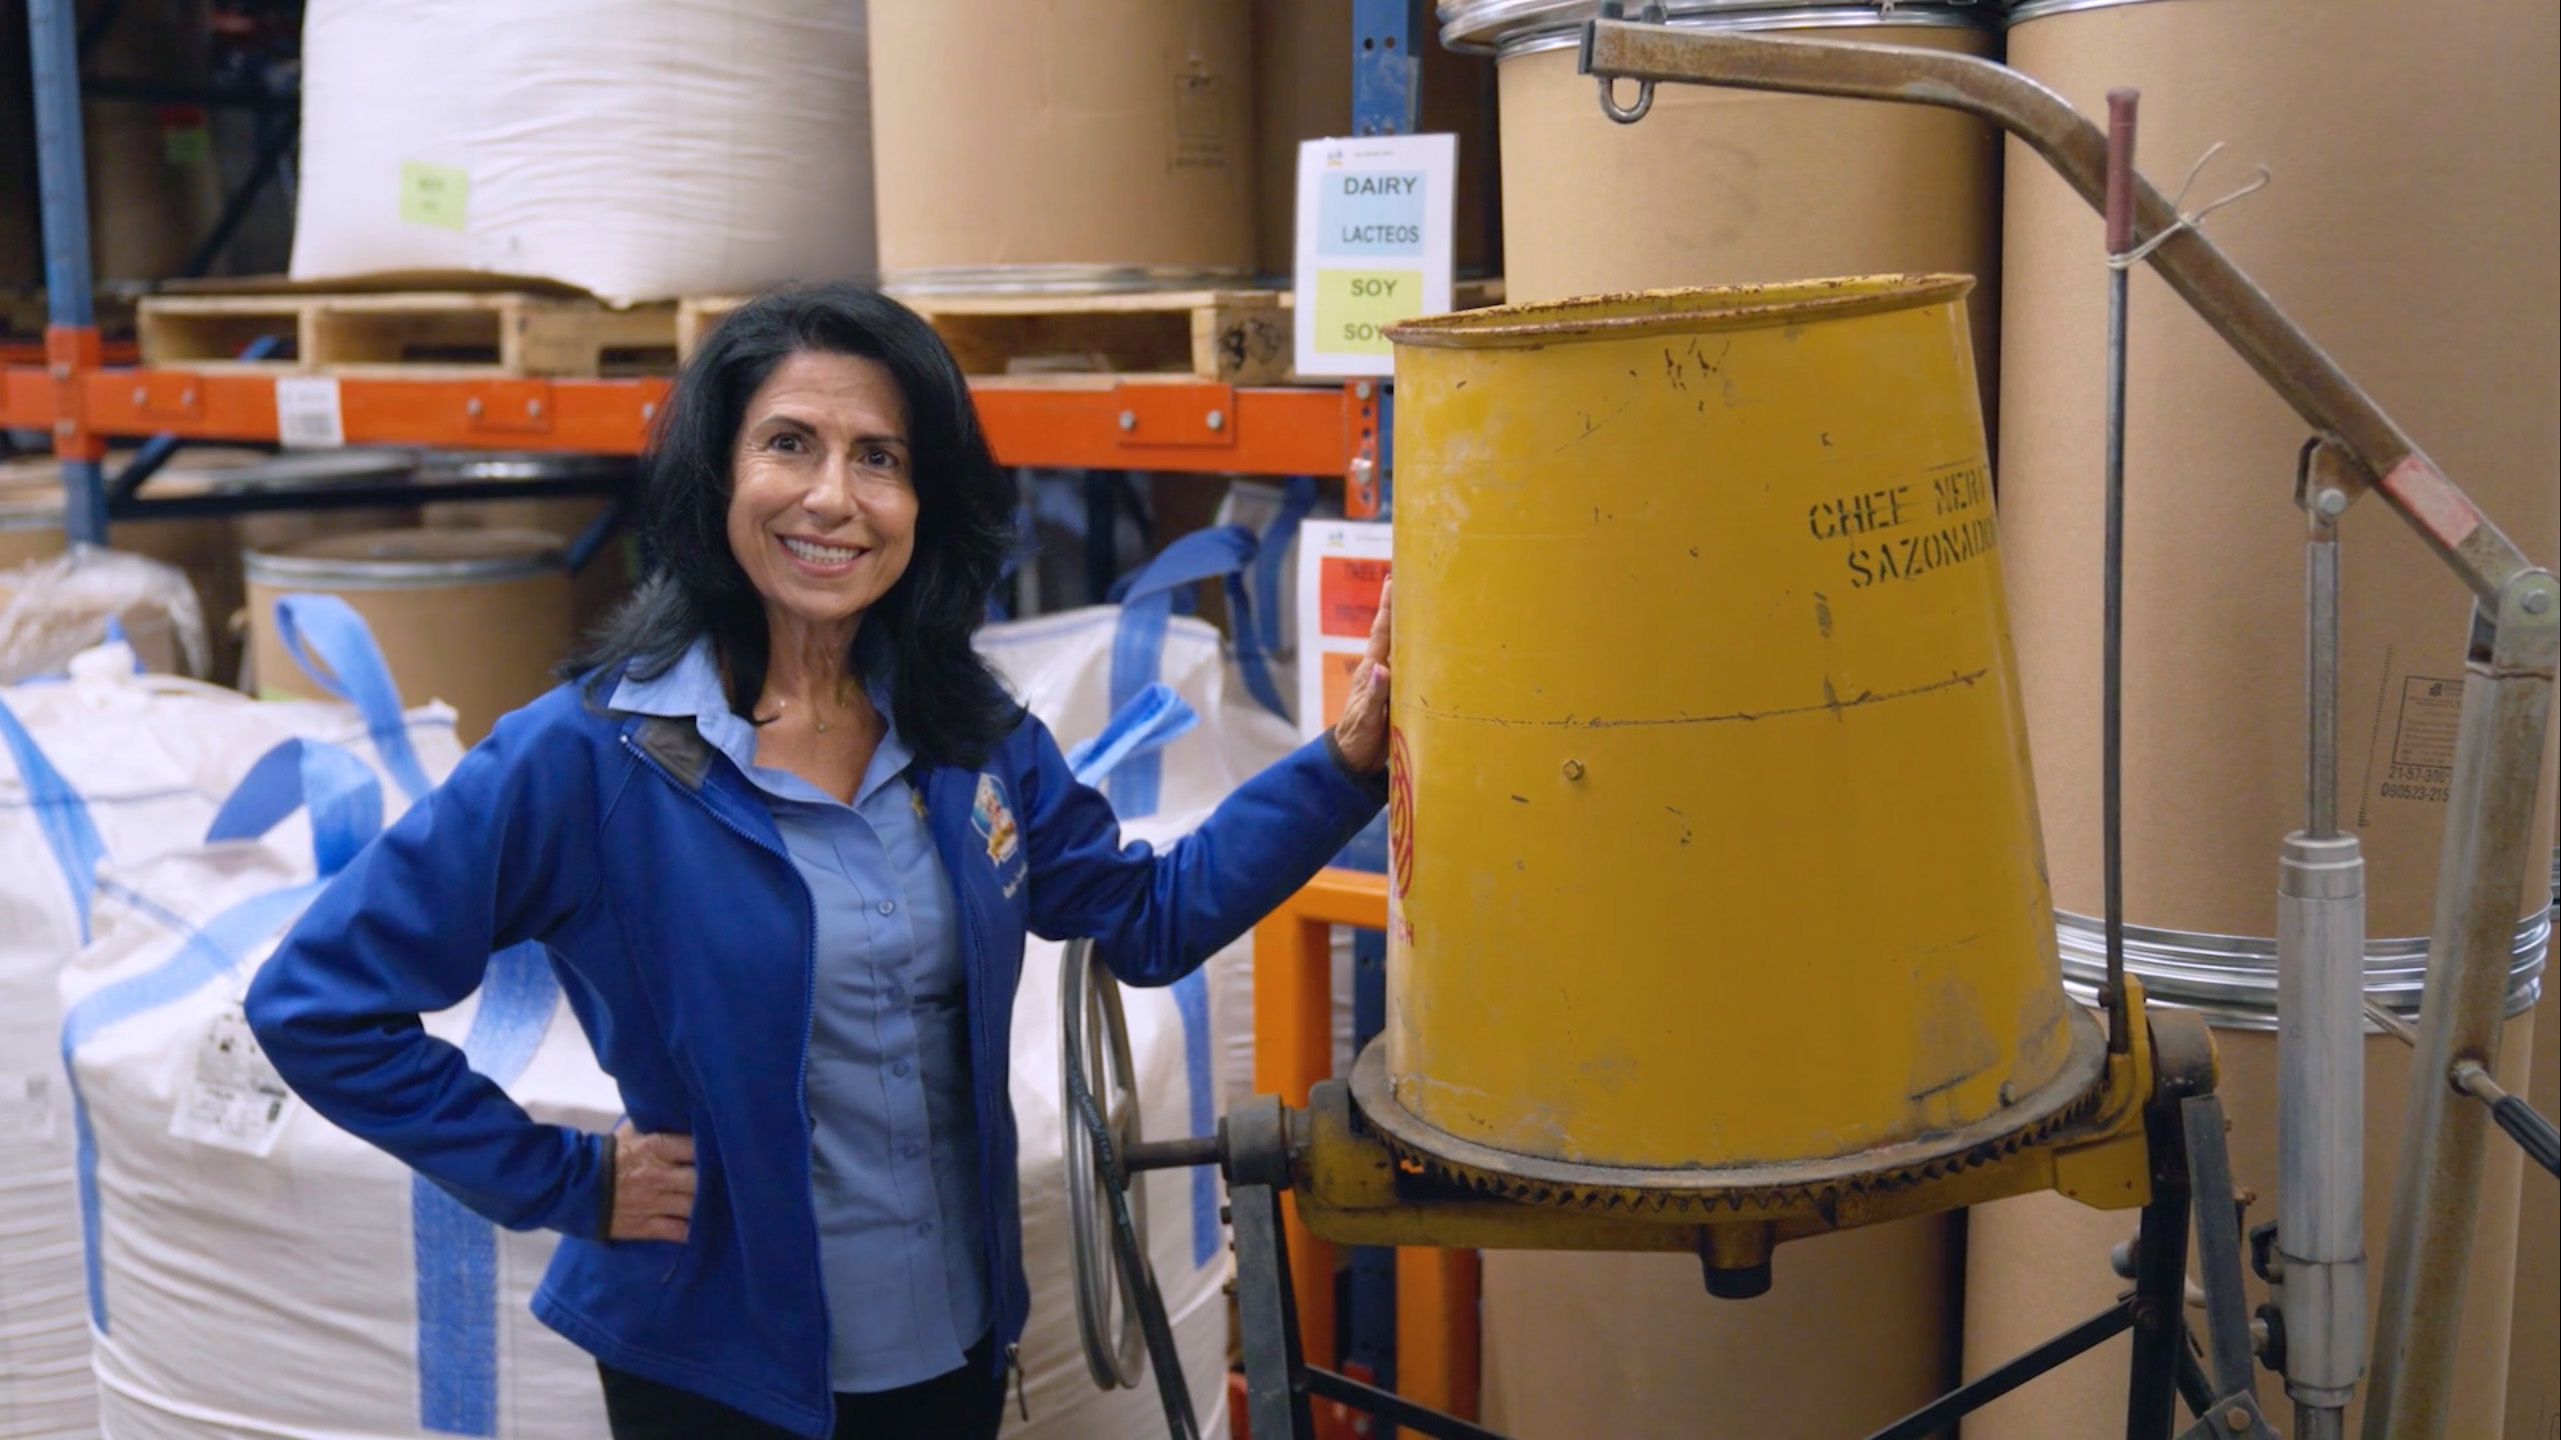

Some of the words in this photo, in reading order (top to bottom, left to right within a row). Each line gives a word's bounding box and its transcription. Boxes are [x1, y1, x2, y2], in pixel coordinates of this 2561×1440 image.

[1343, 178, 1417, 195] DAIRY
[1343, 226, 1419, 243] LACTEOS
[1351, 280, 1397, 297] SOY
[1343, 323, 1385, 341] SOY
[1809, 486, 1909, 540] CHEF
[1848, 516, 1996, 588] SAZONADO
